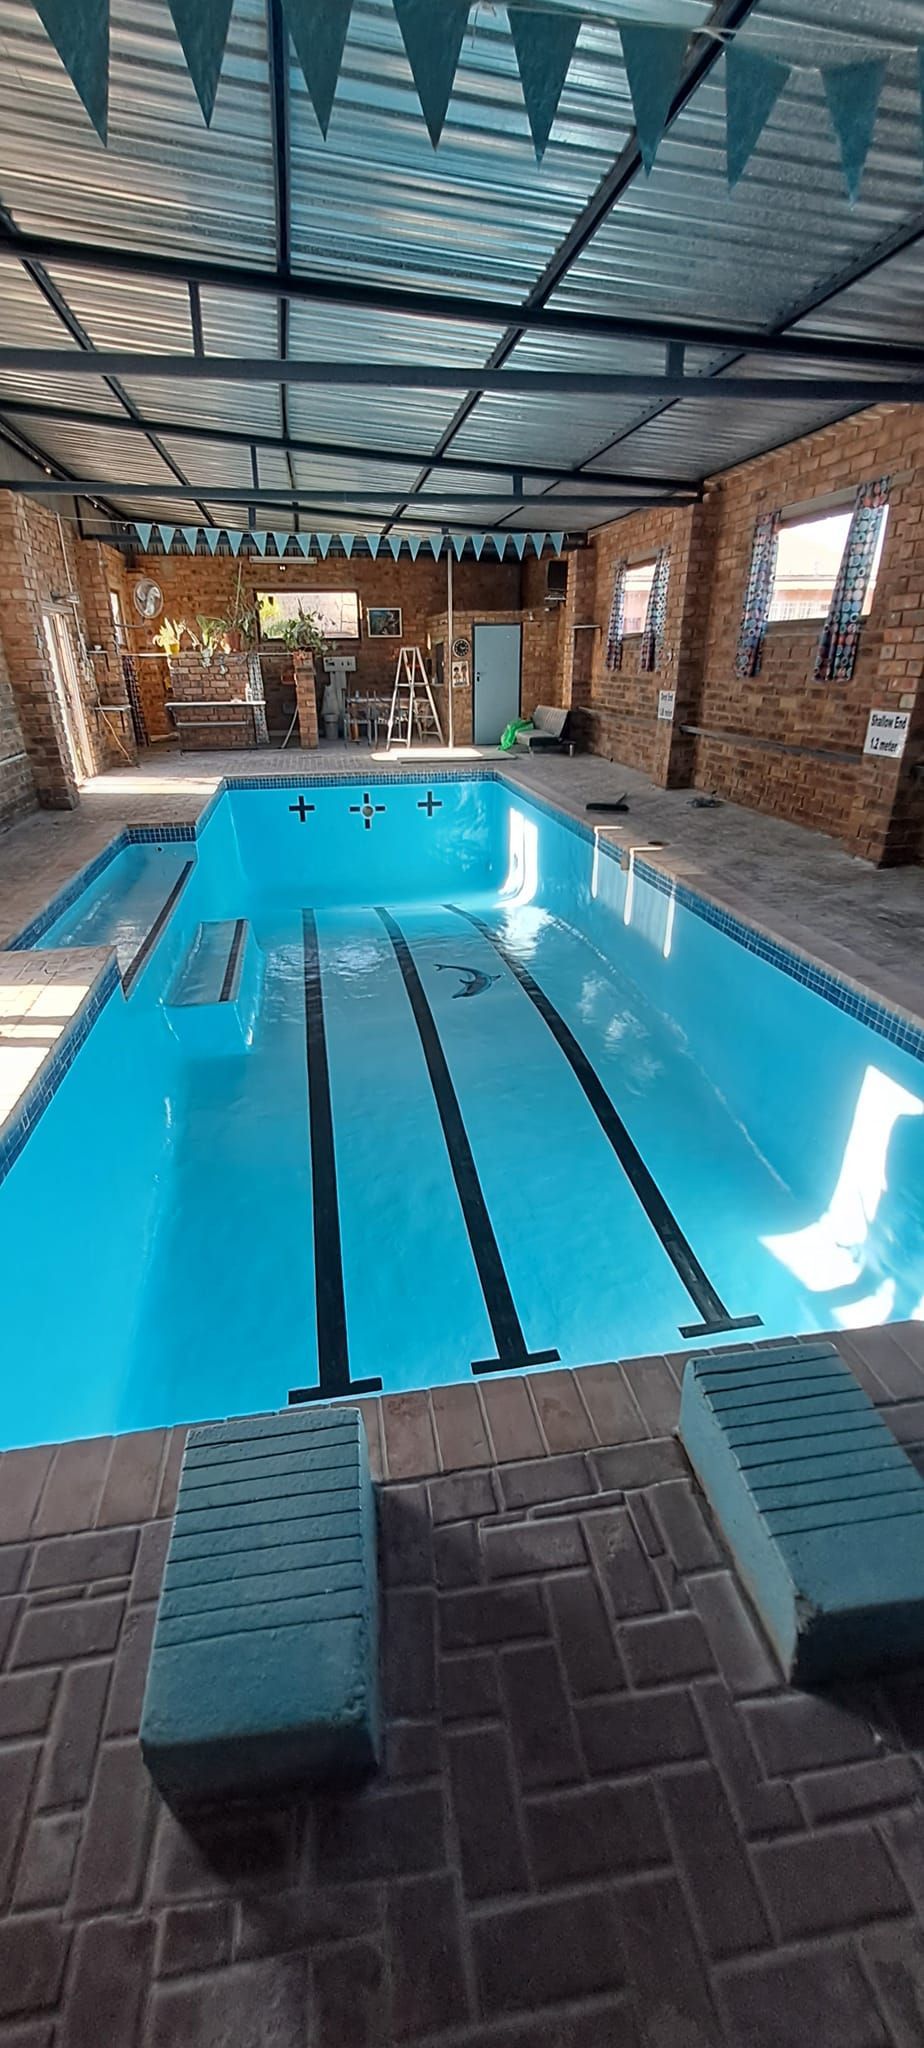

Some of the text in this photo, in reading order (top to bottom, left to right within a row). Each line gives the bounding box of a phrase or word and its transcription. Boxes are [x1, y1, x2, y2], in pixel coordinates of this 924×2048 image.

[871, 714, 907, 729] Shallow End
[879, 740, 898, 752] meter
